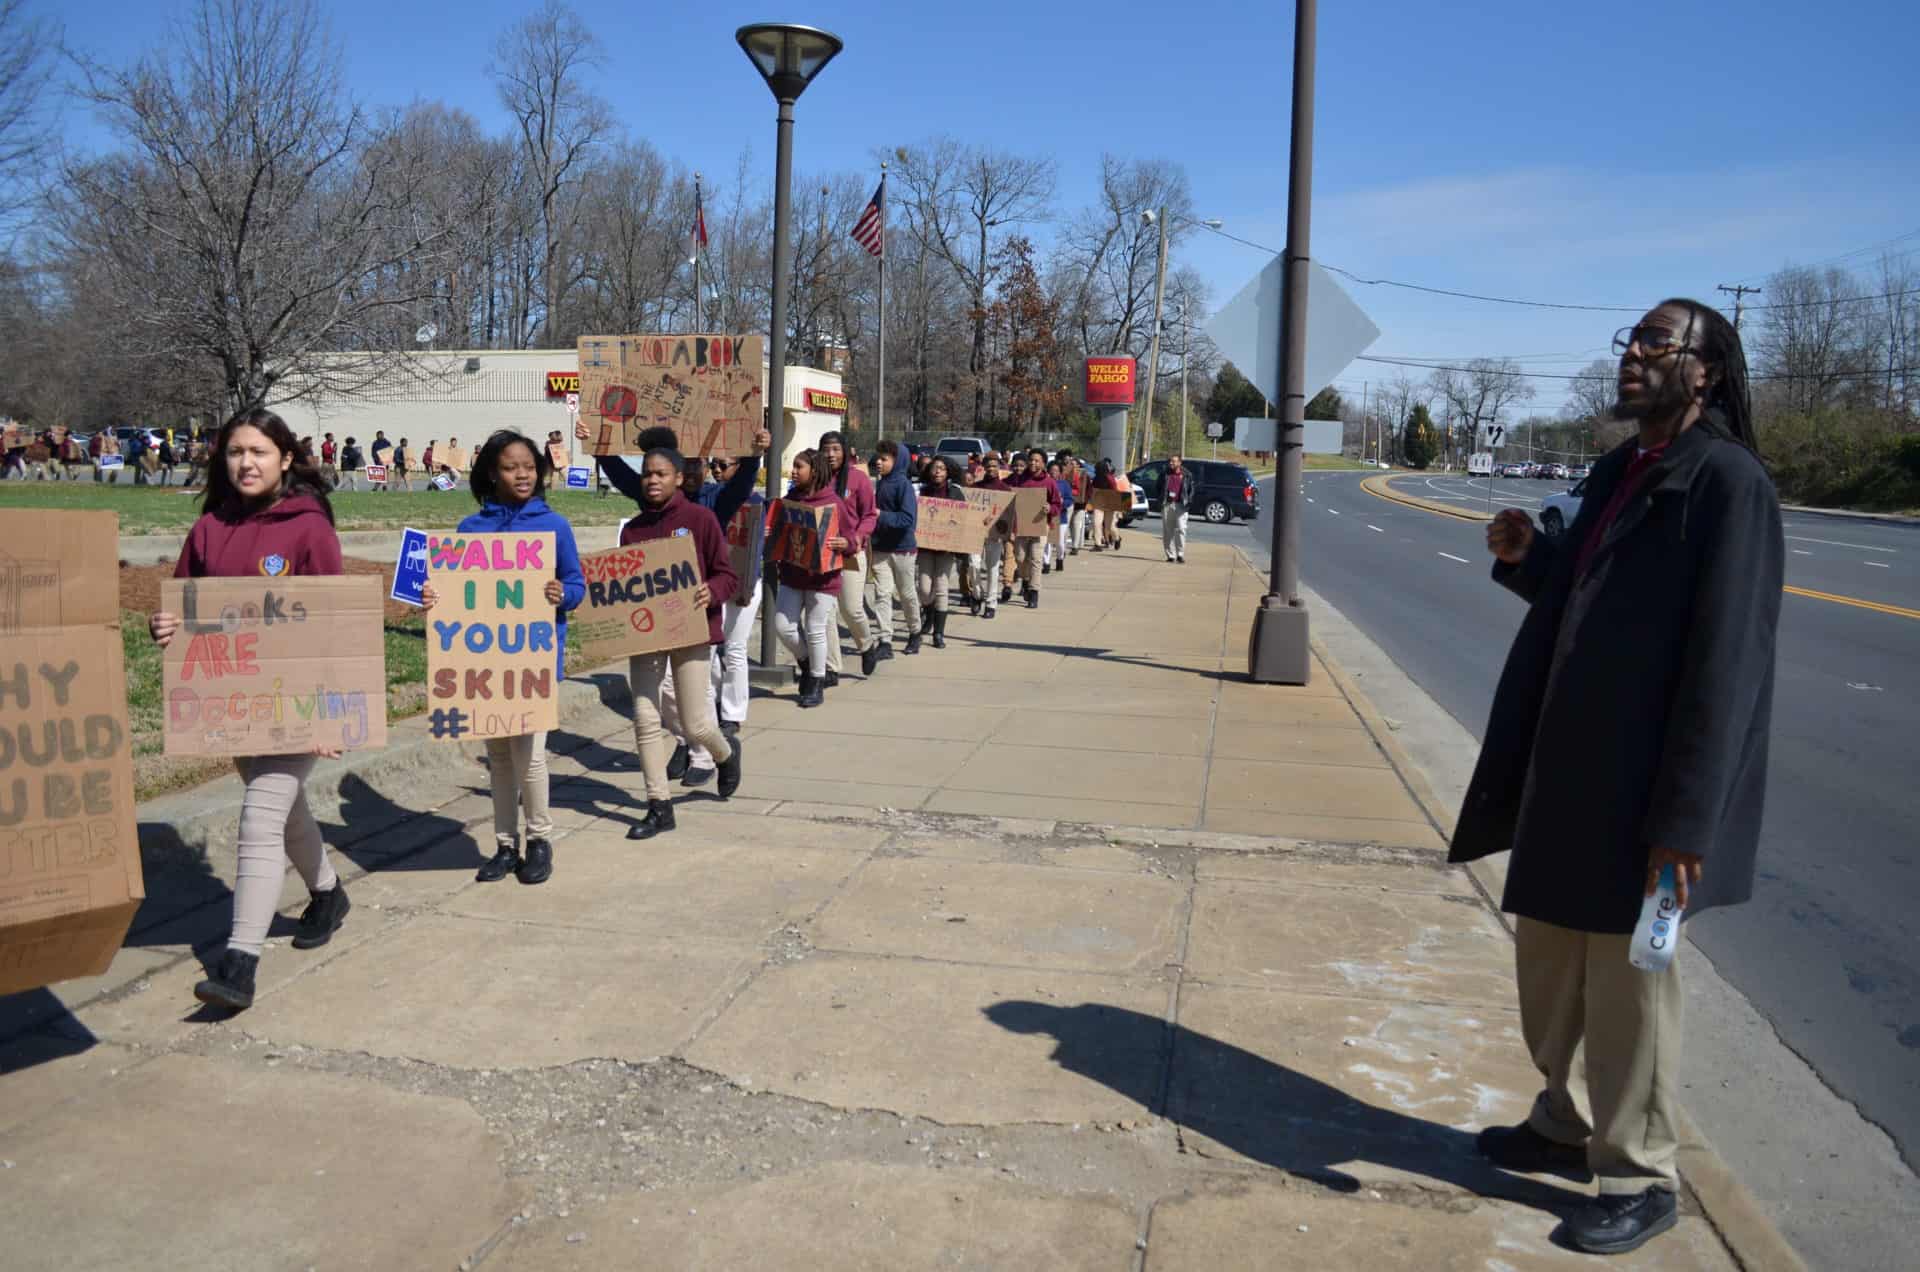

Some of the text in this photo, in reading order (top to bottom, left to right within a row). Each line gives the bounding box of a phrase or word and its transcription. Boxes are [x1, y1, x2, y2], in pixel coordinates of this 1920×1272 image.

[640, 338, 674, 366] NOT
[672, 339, 691, 366] A
[696, 337, 745, 367] BOOK
[1089, 365, 1128, 374] WELLS
[1089, 374, 1129, 384] FARGO
[429, 537, 544, 571] WALK
[464, 579, 525, 610] IN
[589, 560, 697, 608] RACISM
[433, 620, 554, 654] YOUR
[180, 632, 260, 681] ARE
[432, 667, 551, 700] SKIN
[43, 770, 113, 819] BE
[1649, 896, 1675, 950] core
